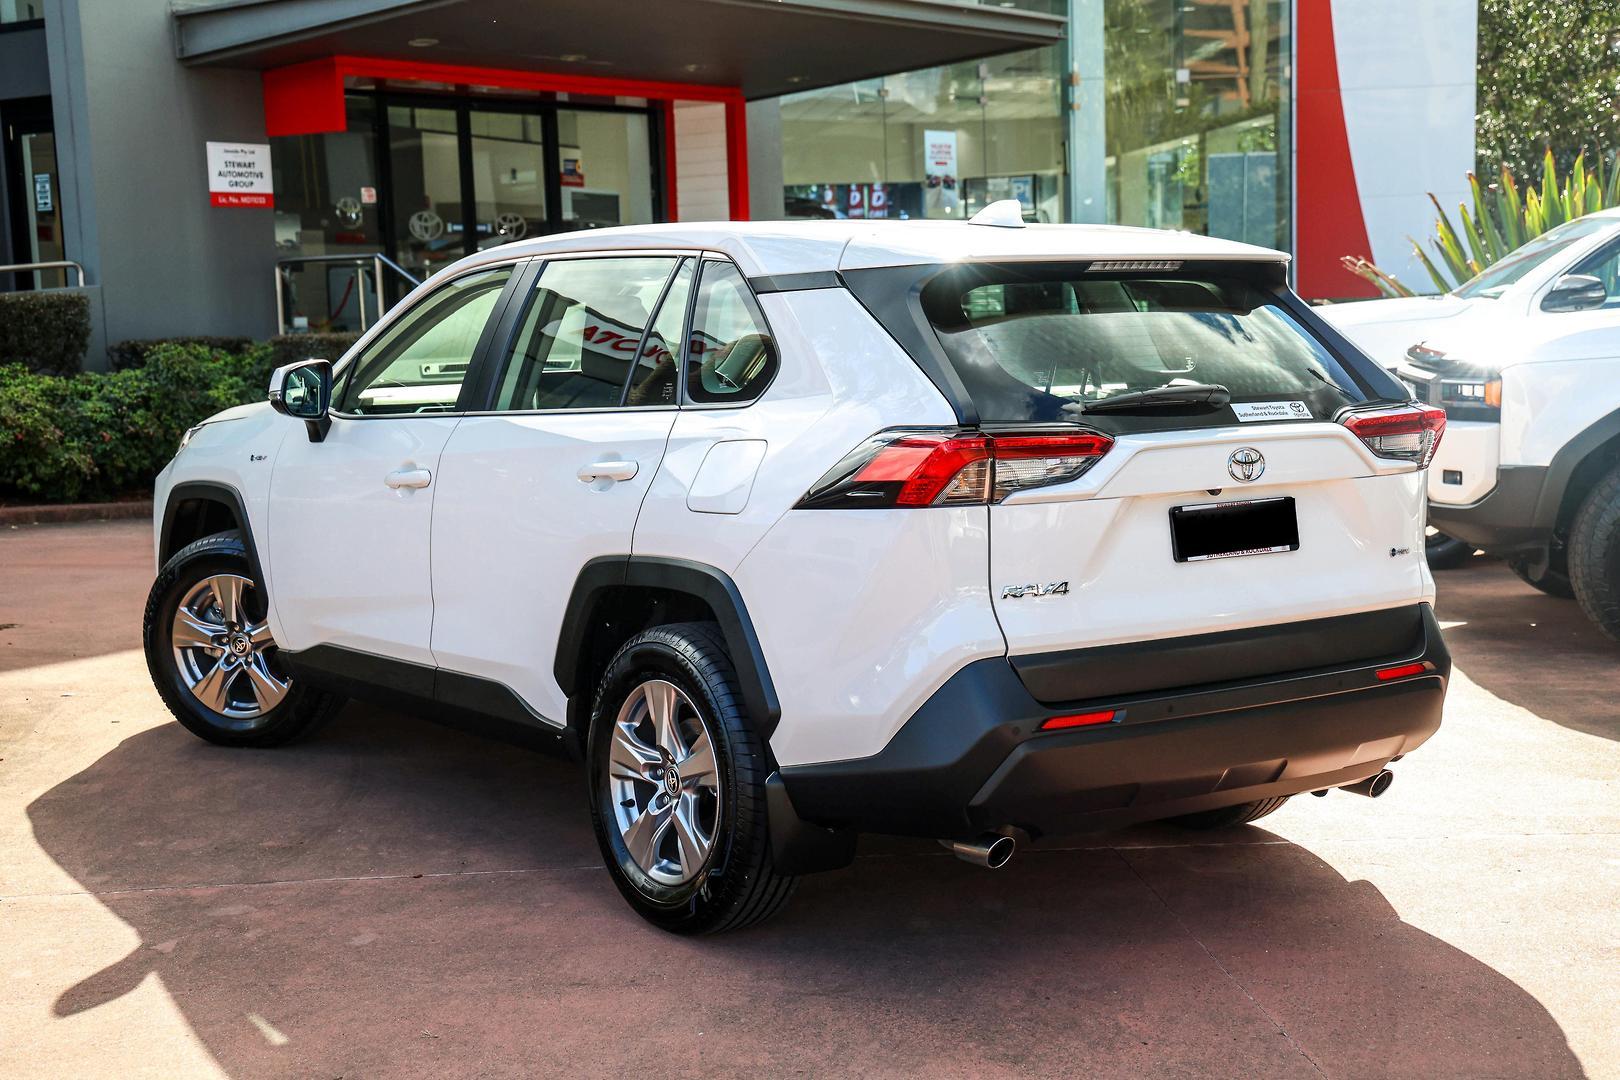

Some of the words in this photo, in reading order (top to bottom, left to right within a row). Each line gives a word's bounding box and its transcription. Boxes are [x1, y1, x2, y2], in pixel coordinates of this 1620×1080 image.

[224, 160, 255, 168] STEWART
[218, 170, 264, 178] AUTOMOTIVE
[228, 180, 254, 188] GROUP
[1001, 581, 1069, 599] RAV4
